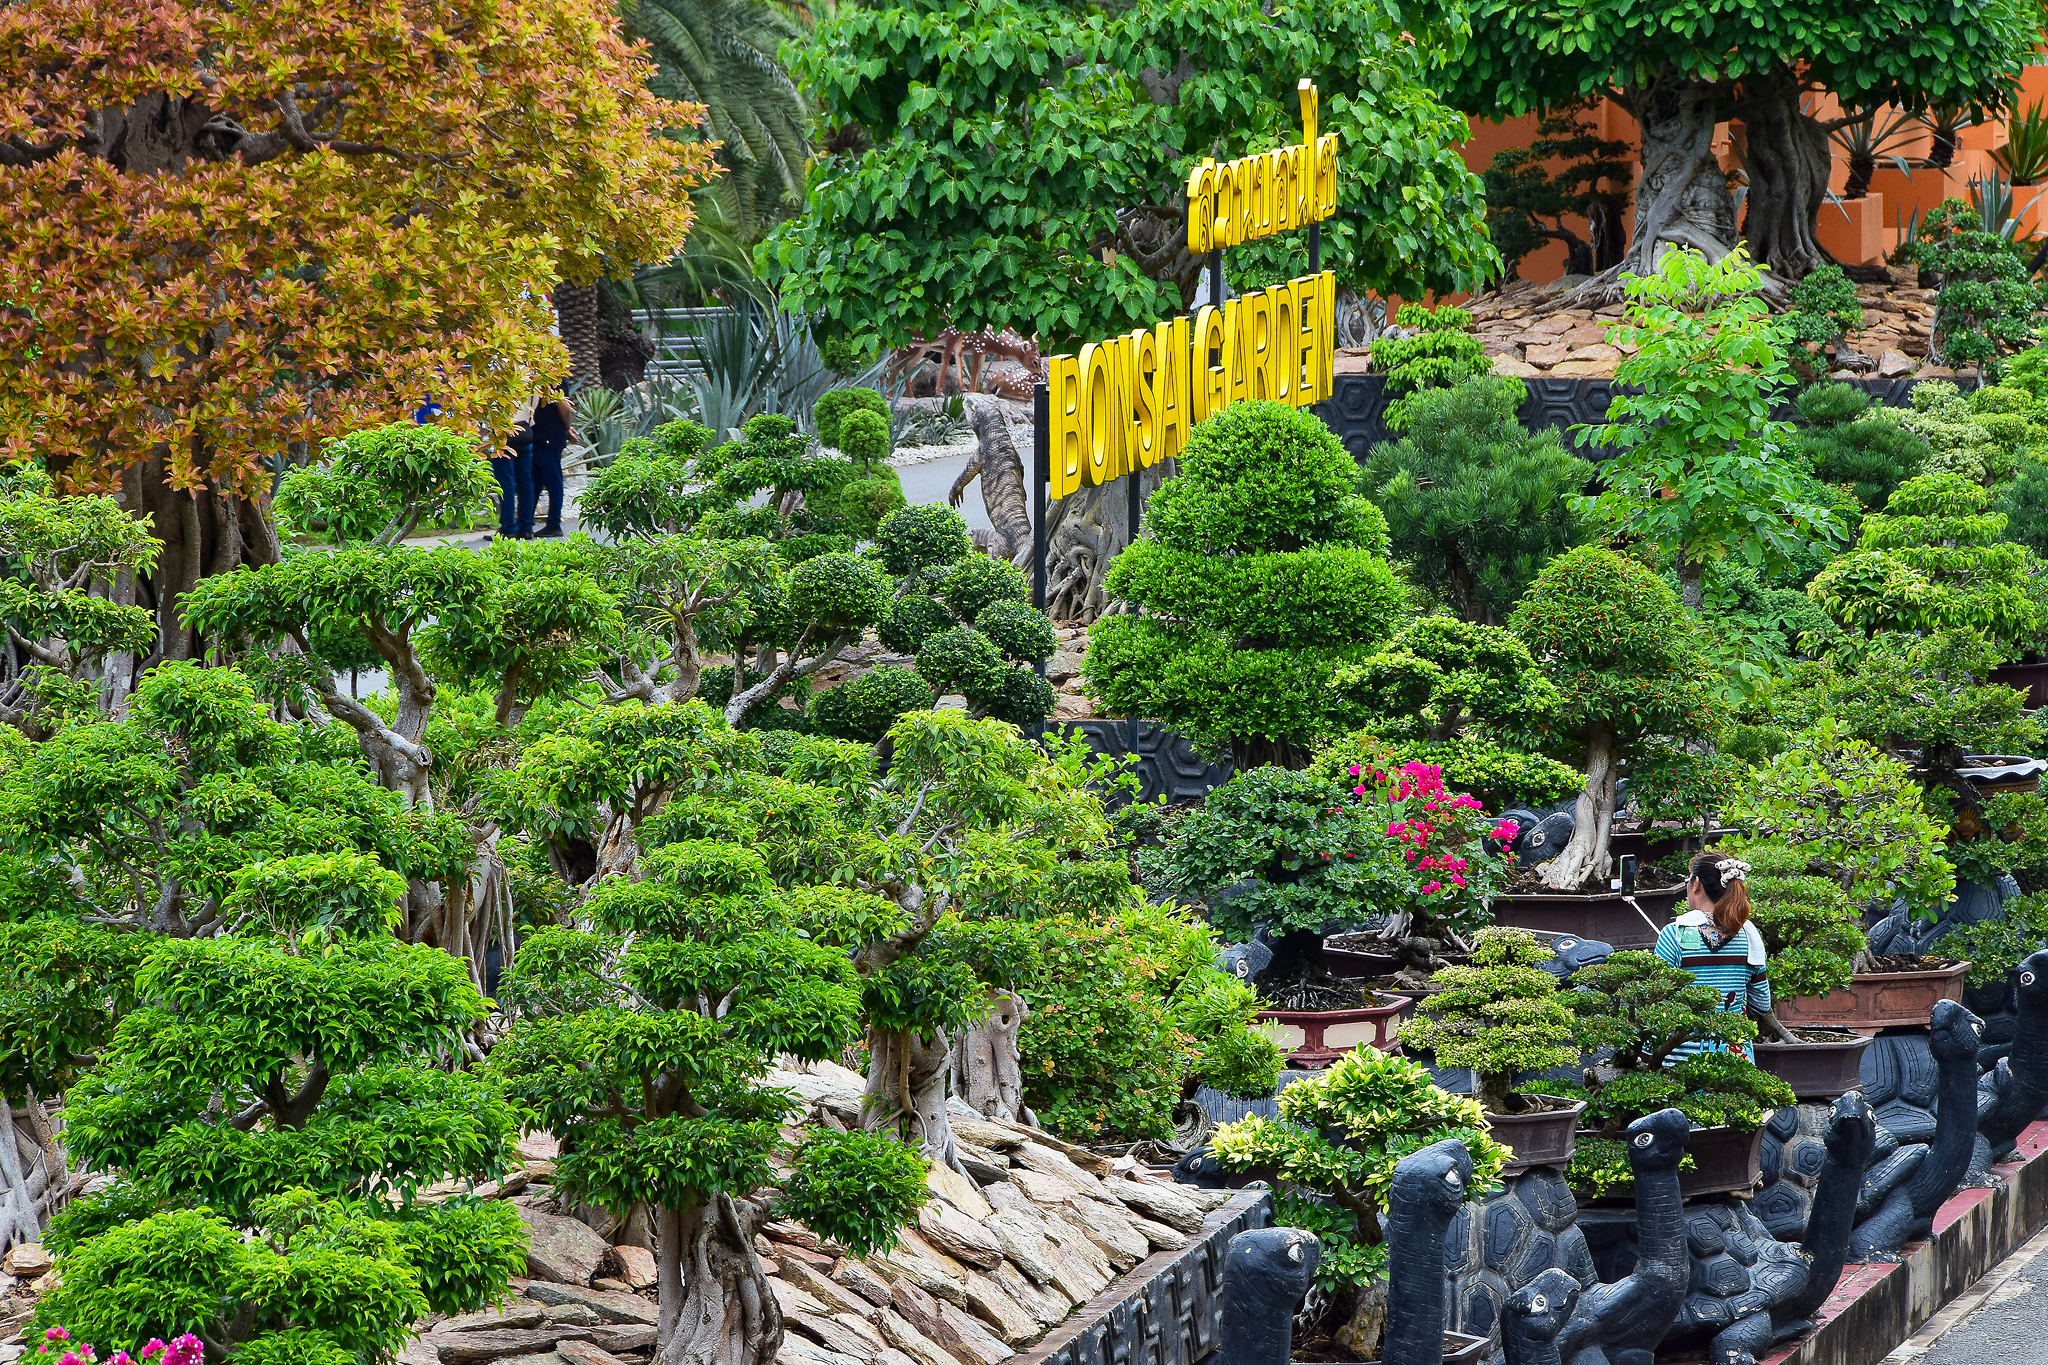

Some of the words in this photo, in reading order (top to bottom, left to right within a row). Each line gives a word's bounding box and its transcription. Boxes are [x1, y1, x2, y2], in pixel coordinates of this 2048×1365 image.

[1187, 78, 1338, 256] สวนบอนไซ
[1049, 316, 1190, 500] BONSAI
[1192, 270, 1336, 423] GARDEN
